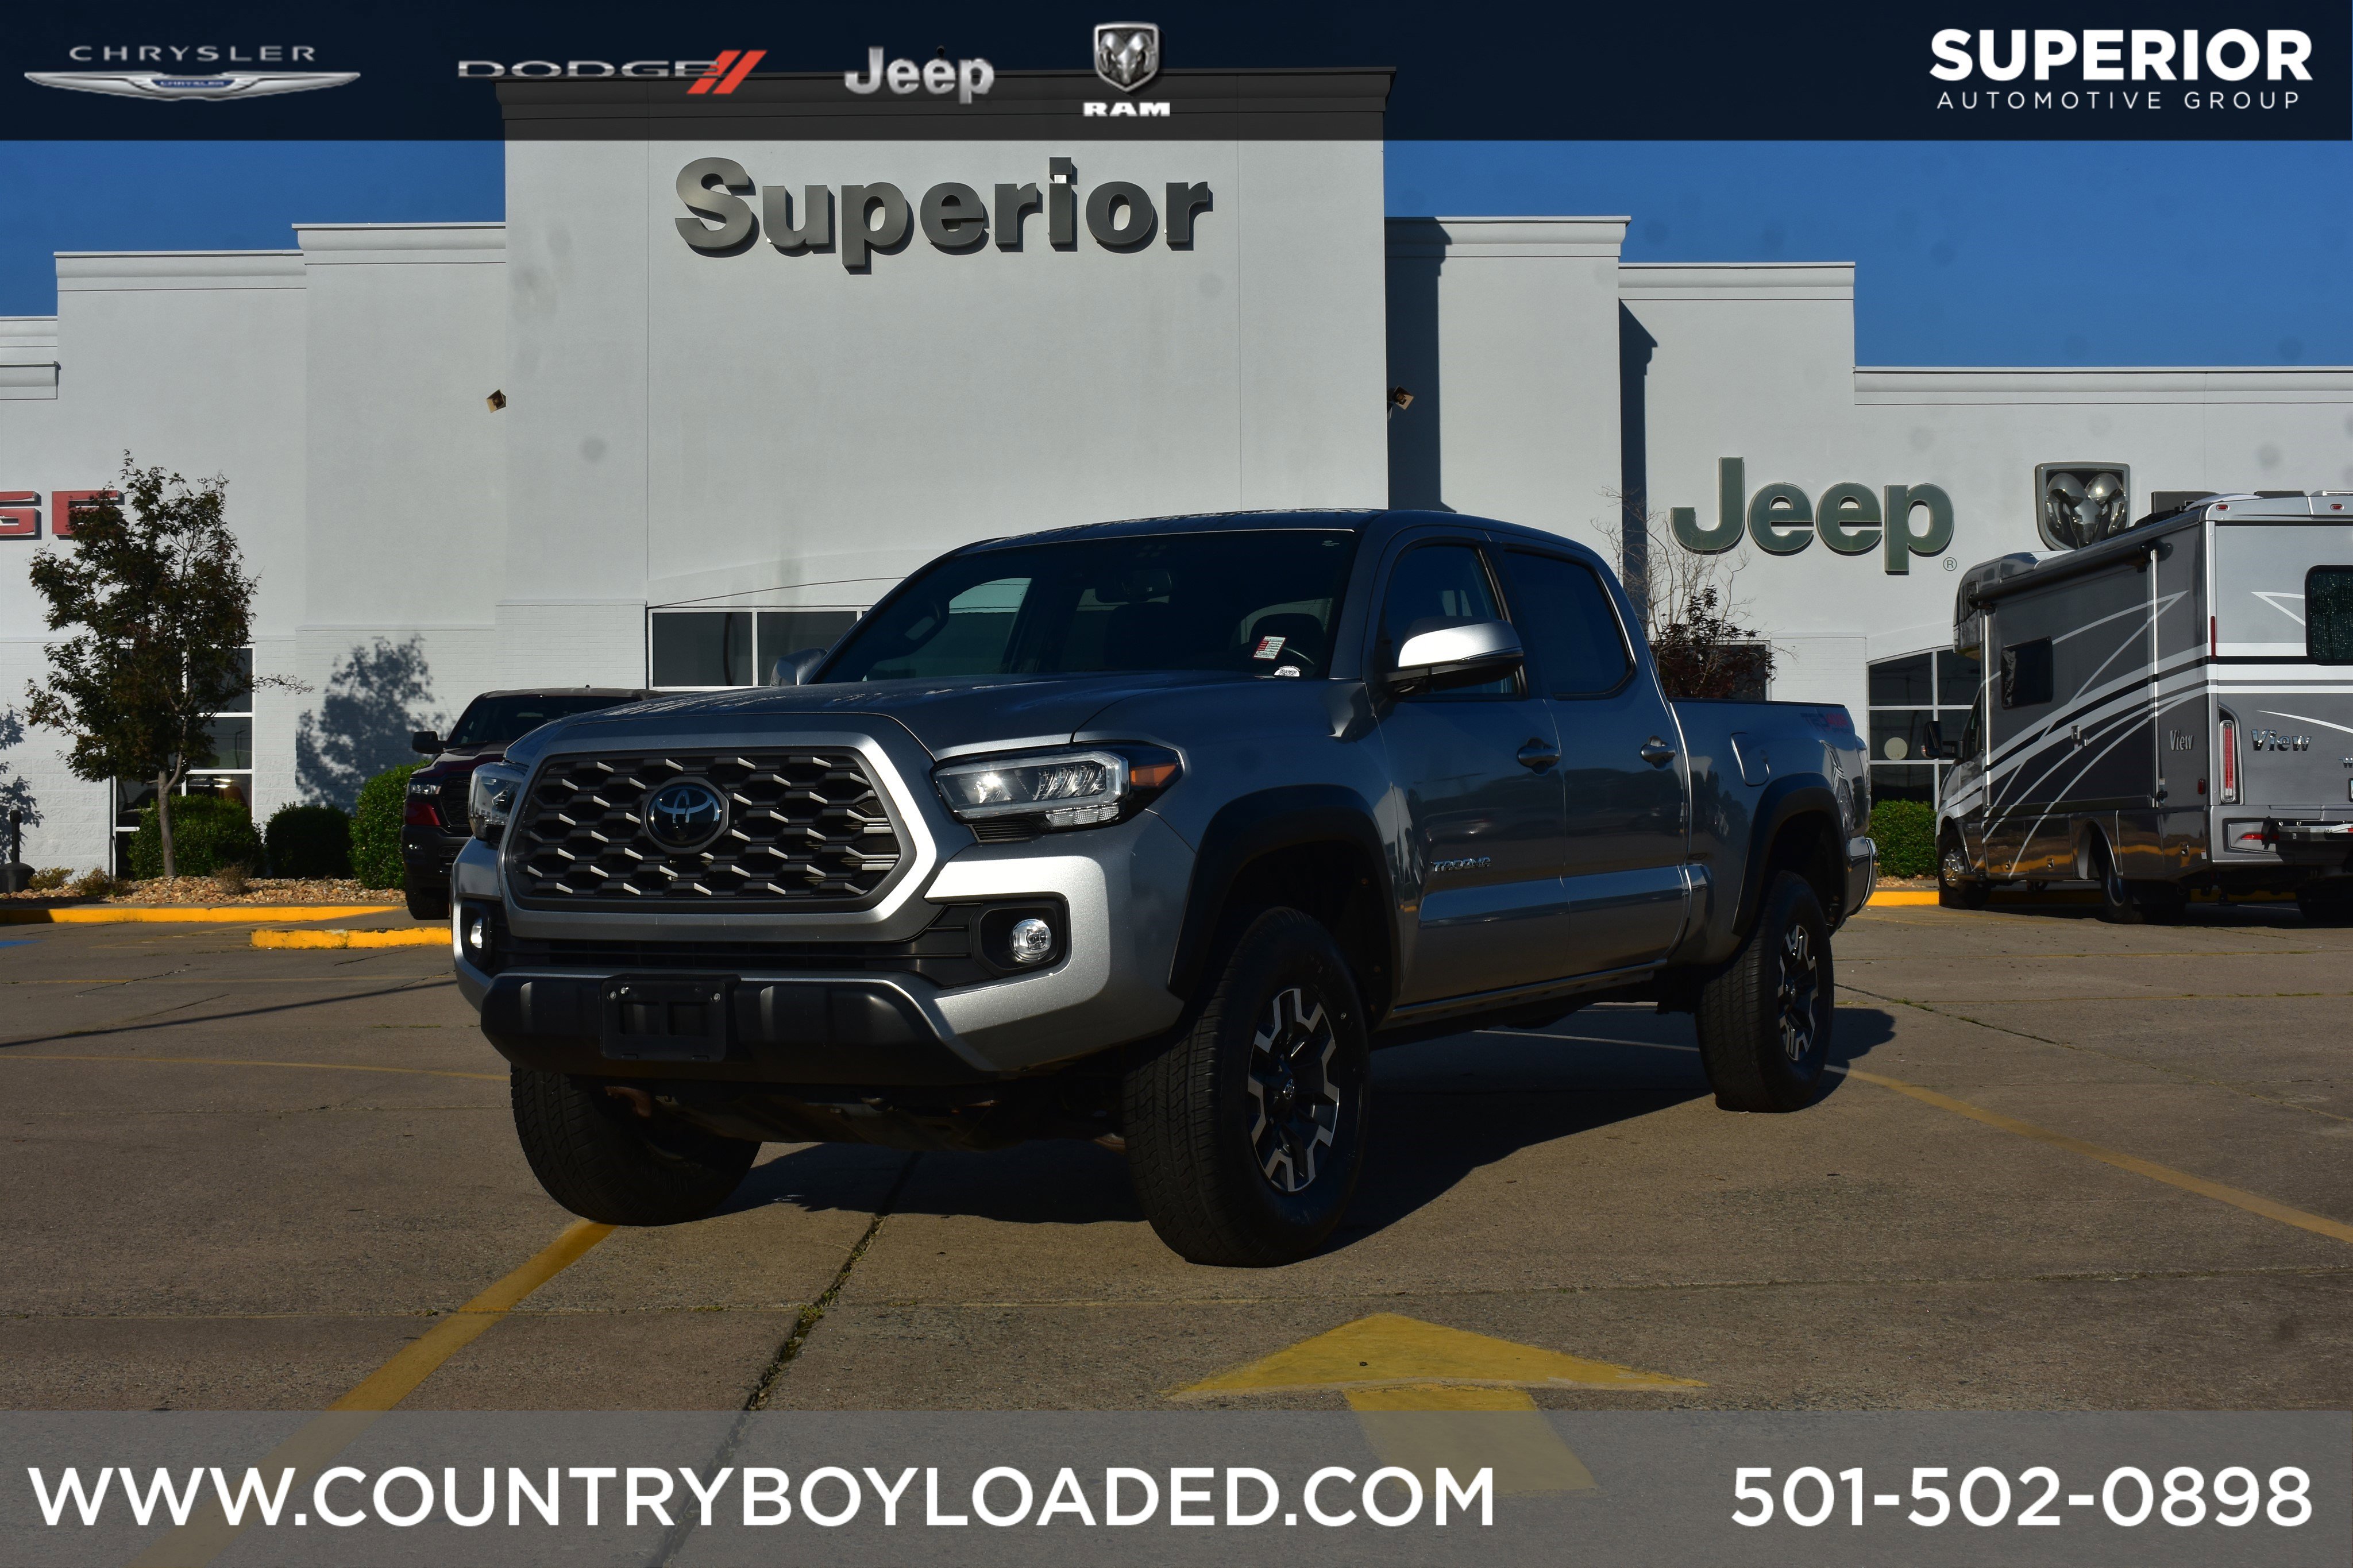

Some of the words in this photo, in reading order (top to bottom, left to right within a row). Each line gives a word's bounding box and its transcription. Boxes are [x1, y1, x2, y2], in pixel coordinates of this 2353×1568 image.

[675, 156, 1209, 268] Superior
[1671, 457, 1954, 576] Jeep
[2170, 729, 2194, 751] View
[2250, 729, 2312, 751] View
